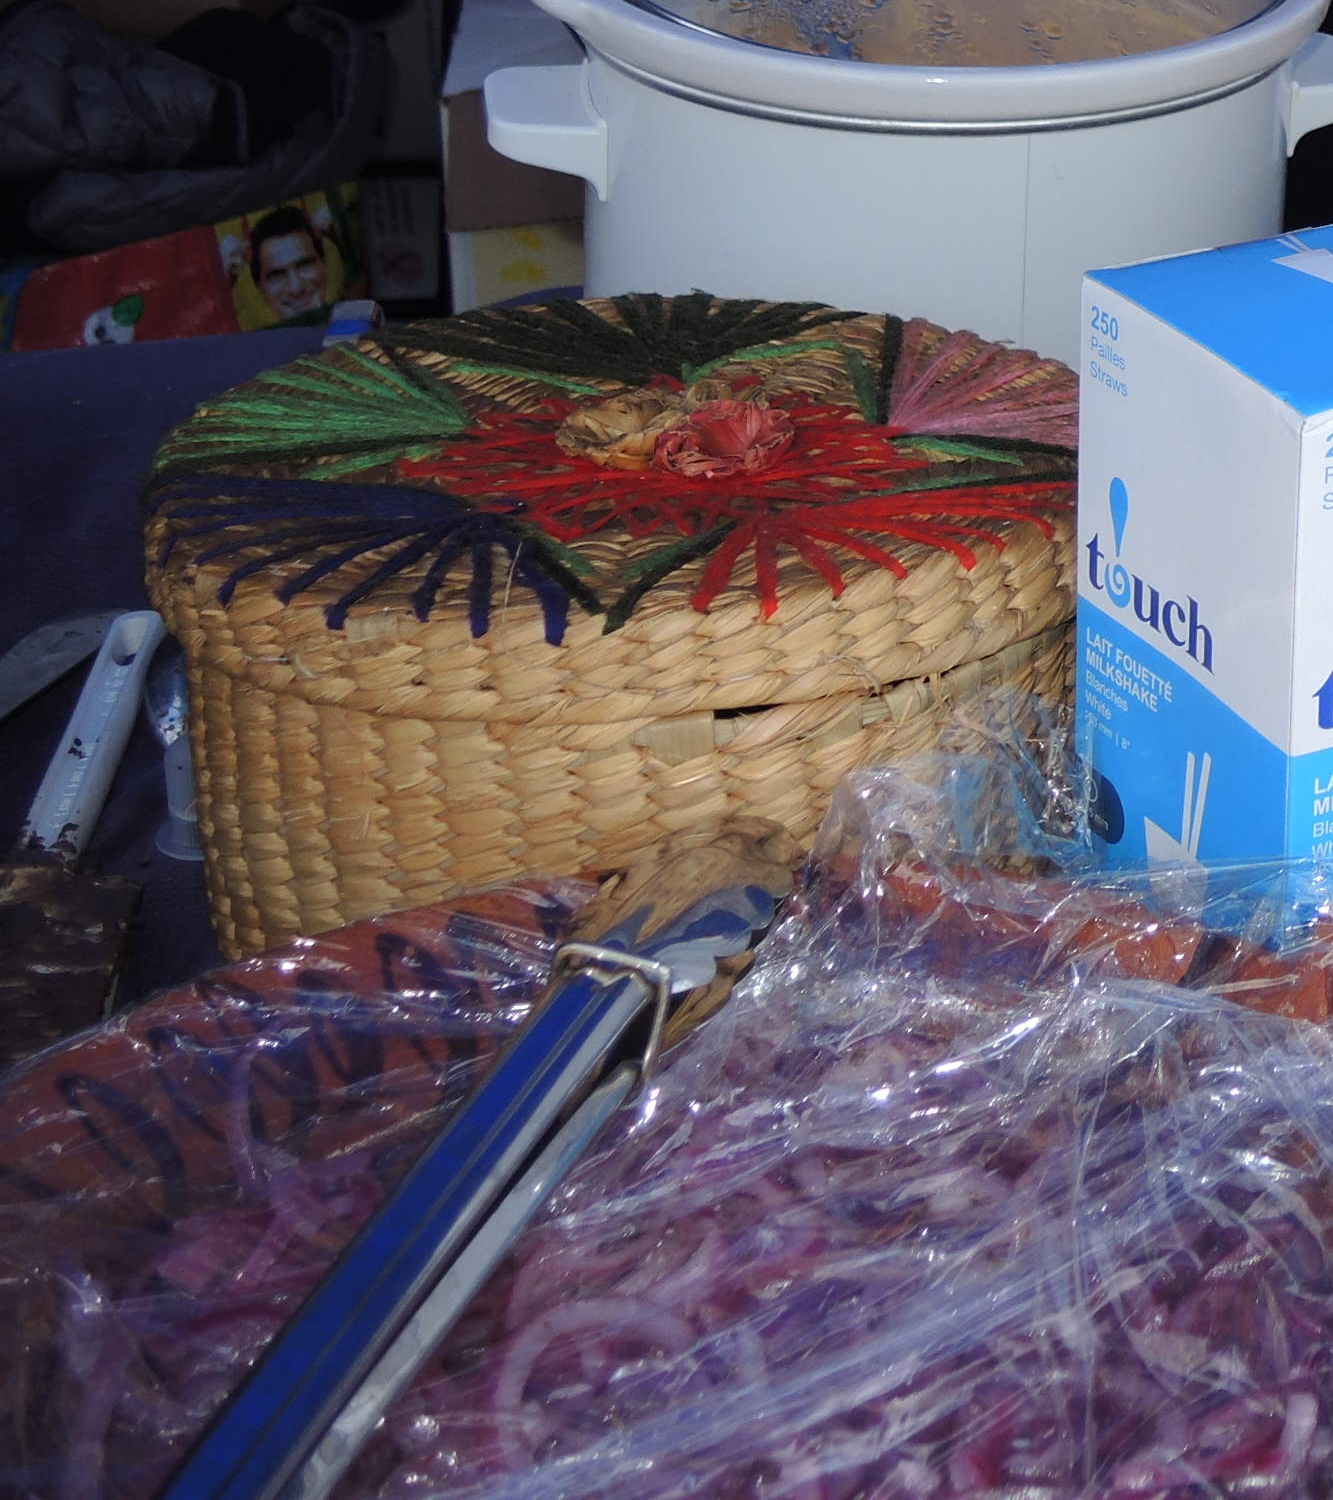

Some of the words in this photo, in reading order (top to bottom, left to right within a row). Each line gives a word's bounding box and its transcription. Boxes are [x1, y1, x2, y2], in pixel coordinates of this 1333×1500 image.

[1091, 305, 1119, 341] 250
[1091, 335, 1126, 371] Pailles
[1090, 360, 1128, 397] Straws
[1086, 532, 1215, 676] touch
[1086, 627, 1114, 658] LAIT
[1115, 647, 1173, 703] FOUETTÉ
[1086, 647, 1158, 712] MILKSHAKE
[1085, 669, 1128, 712] Blanches
[1085, 689, 1112, 720] White
